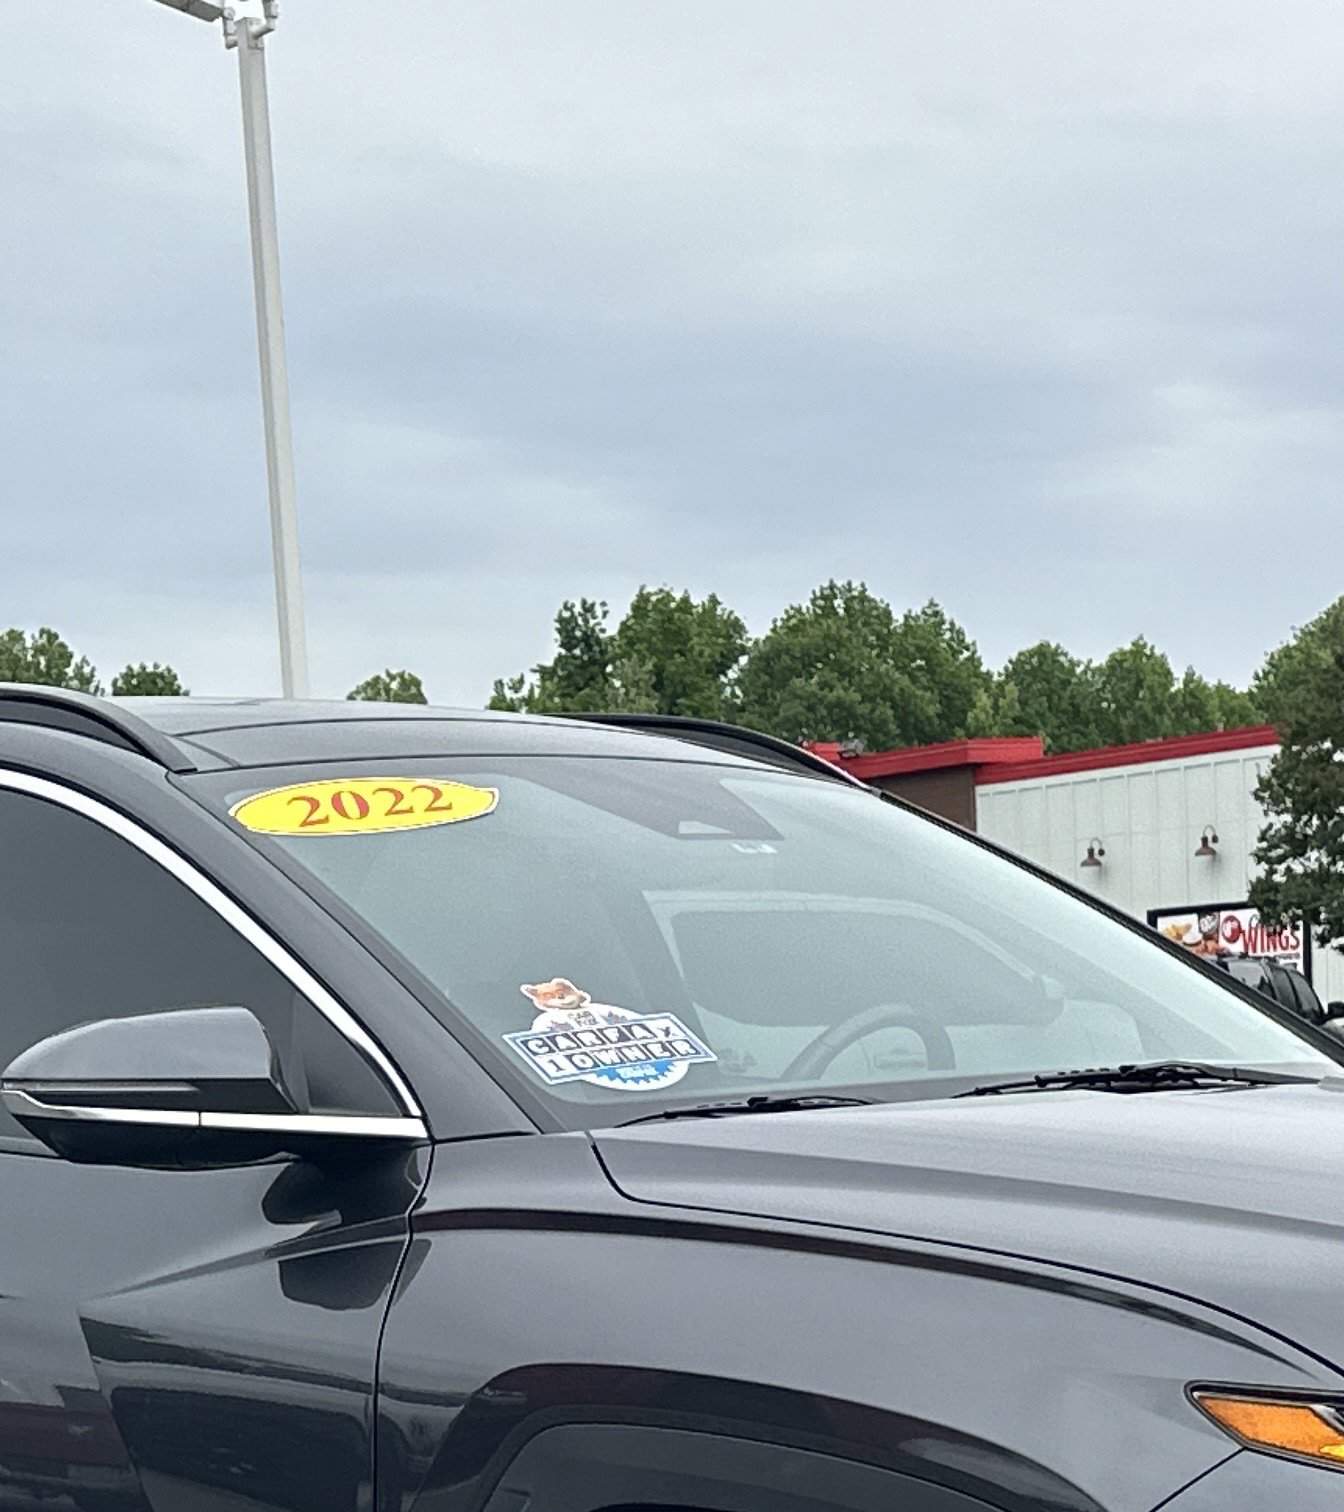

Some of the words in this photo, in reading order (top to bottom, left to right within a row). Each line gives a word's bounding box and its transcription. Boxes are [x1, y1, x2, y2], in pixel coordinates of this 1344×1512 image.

[285, 784, 454, 828] 2022
[1240, 924, 1301, 954] WINGS
[523, 1022, 677, 1056] CARFAX
[548, 1056, 563, 1072] 1
[568, 1039, 698, 1070] OWNER
